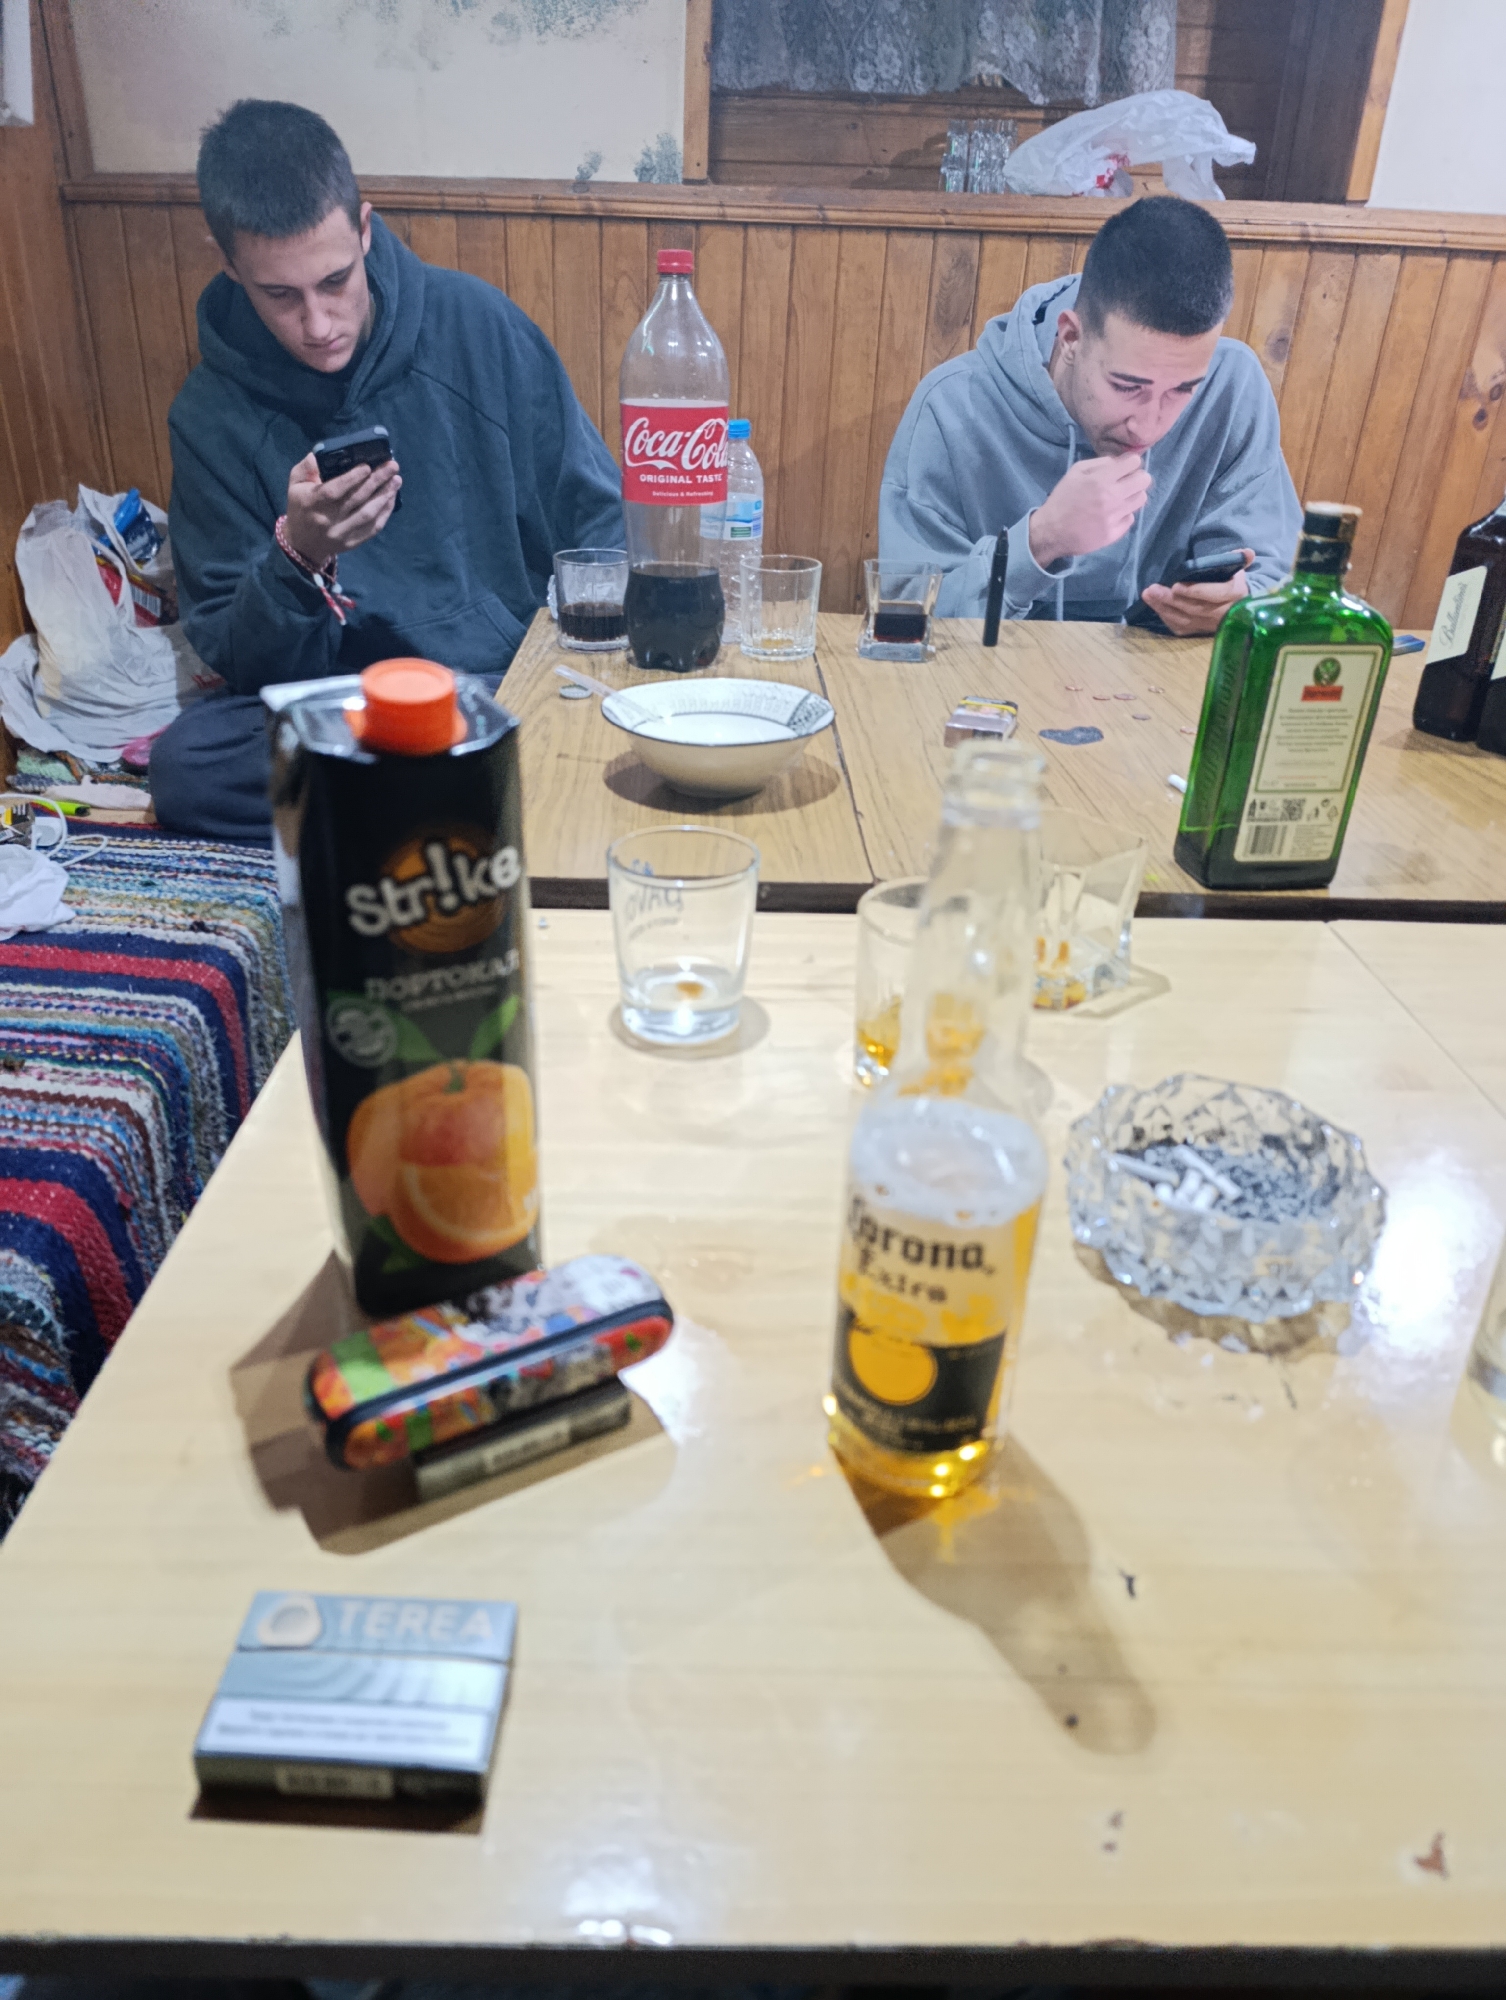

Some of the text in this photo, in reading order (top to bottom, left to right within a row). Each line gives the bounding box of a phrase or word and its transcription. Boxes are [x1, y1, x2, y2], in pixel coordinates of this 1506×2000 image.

[624, 417, 728, 471] Coca-Cola
[639, 473, 723, 484] ORIGINAL TASTE
[337, 1600, 494, 1641] TEREA
